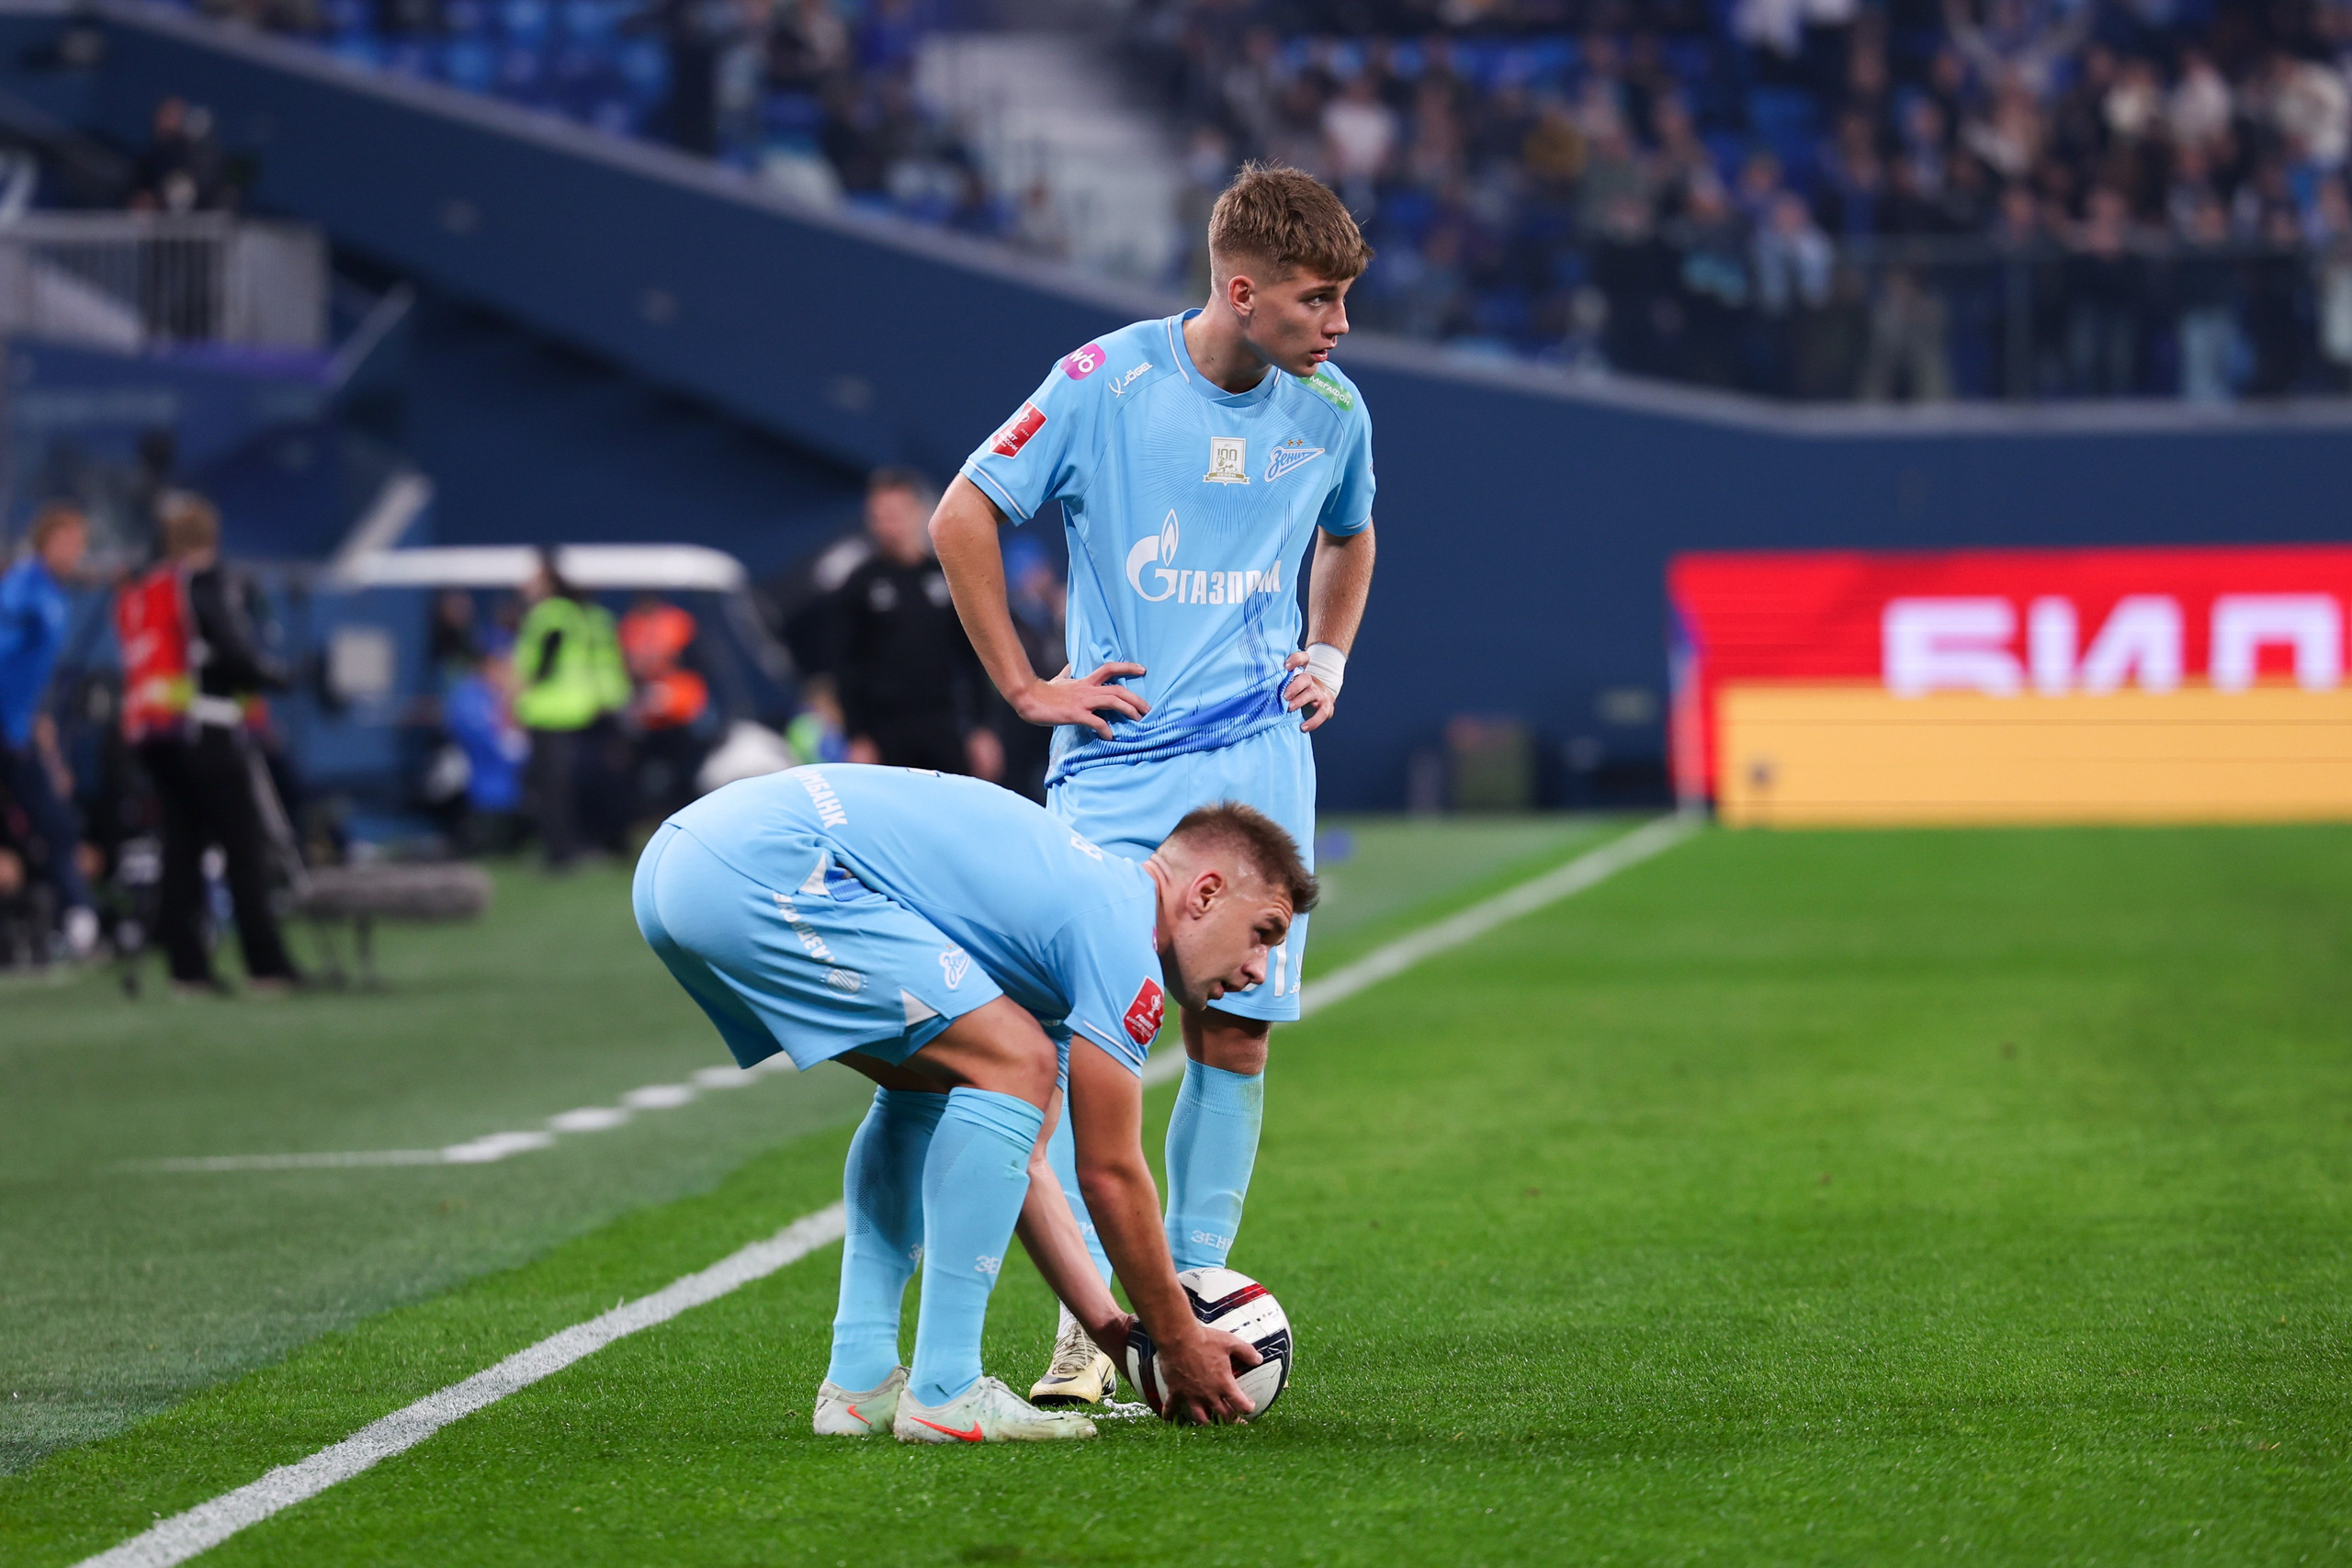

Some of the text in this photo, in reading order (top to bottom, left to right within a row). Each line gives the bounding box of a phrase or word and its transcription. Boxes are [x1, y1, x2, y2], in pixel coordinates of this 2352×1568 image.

[1069, 349, 1096, 373] wb
[1123, 361, 1154, 387] JÖGEL
[1309, 375, 1351, 406] МЕГАФОН
[1177, 559, 1283, 605] ГАЗПРМ
